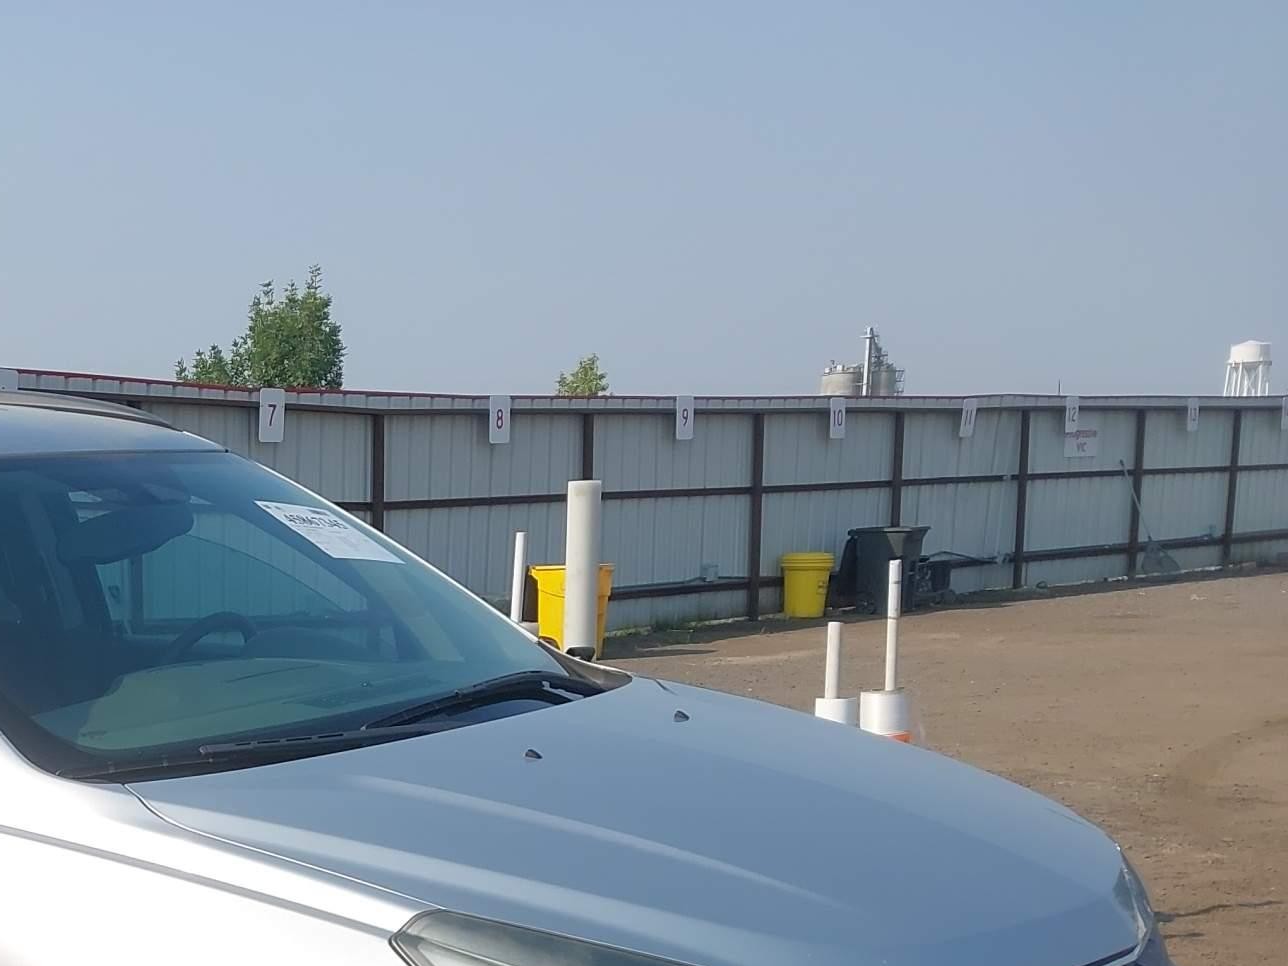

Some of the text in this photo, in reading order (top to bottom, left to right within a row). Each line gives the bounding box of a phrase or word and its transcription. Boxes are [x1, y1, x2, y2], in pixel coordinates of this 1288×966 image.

[267, 403, 277, 427] 7
[496, 409, 504, 430] 8
[681, 408, 689, 427] 9
[832, 409, 843, 427] 10
[963, 408, 974, 425] 11
[1068, 407, 1077, 423] 12
